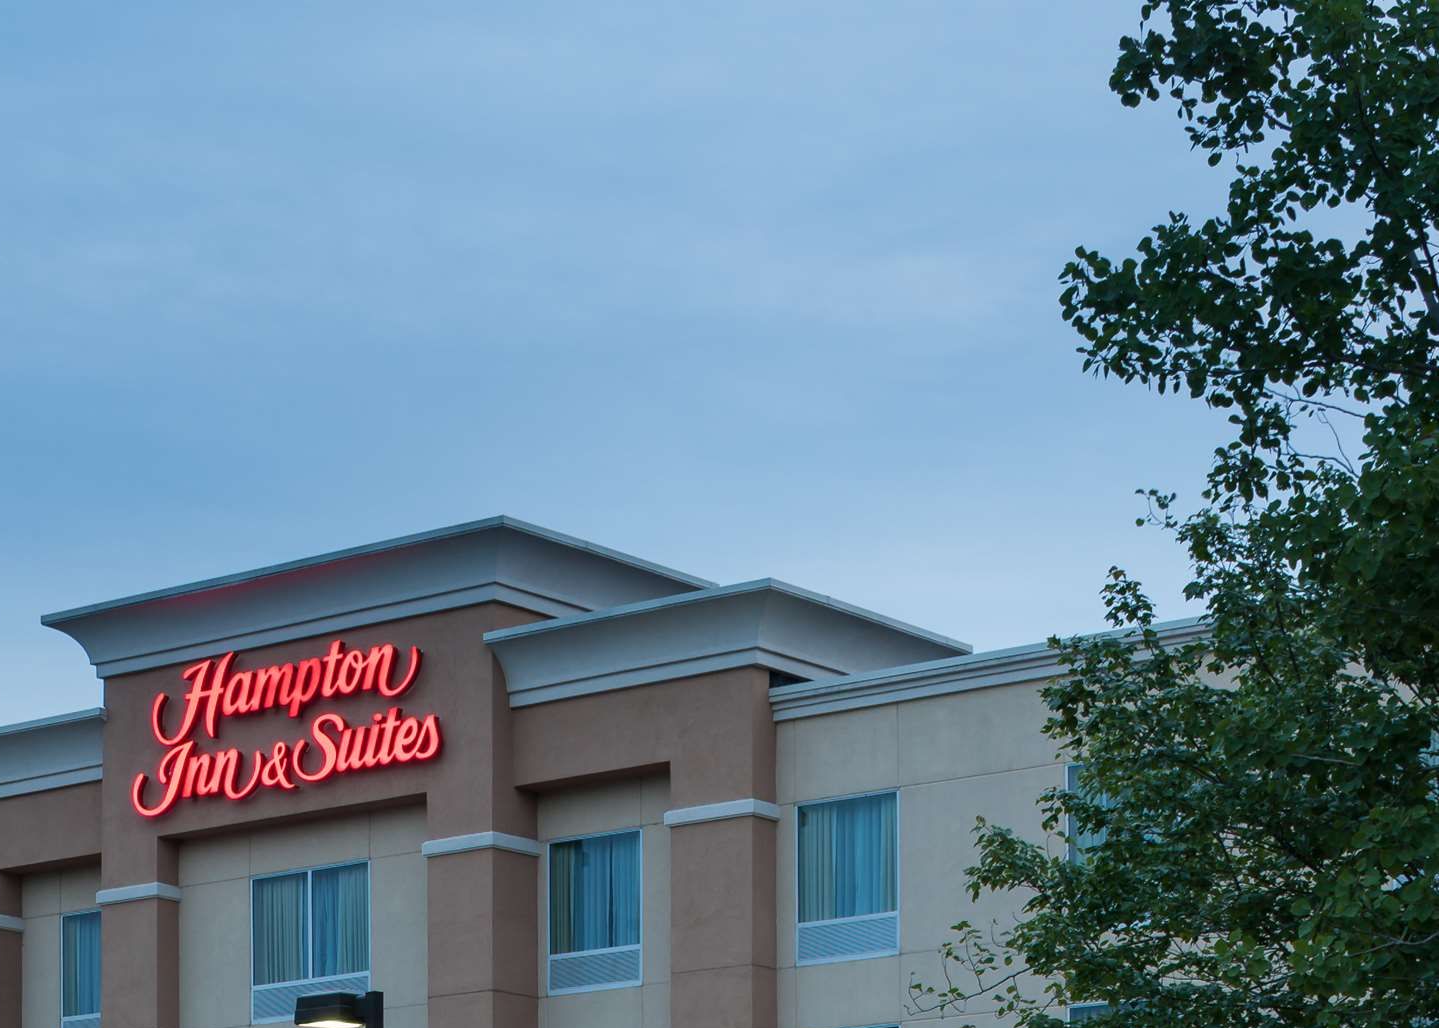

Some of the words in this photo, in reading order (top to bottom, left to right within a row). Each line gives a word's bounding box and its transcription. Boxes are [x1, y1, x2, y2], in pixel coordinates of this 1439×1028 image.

[152, 639, 423, 746] Hampton
[132, 740, 265, 817] Inn
[262, 741, 298, 789] &
[292, 706, 444, 782] Suites
